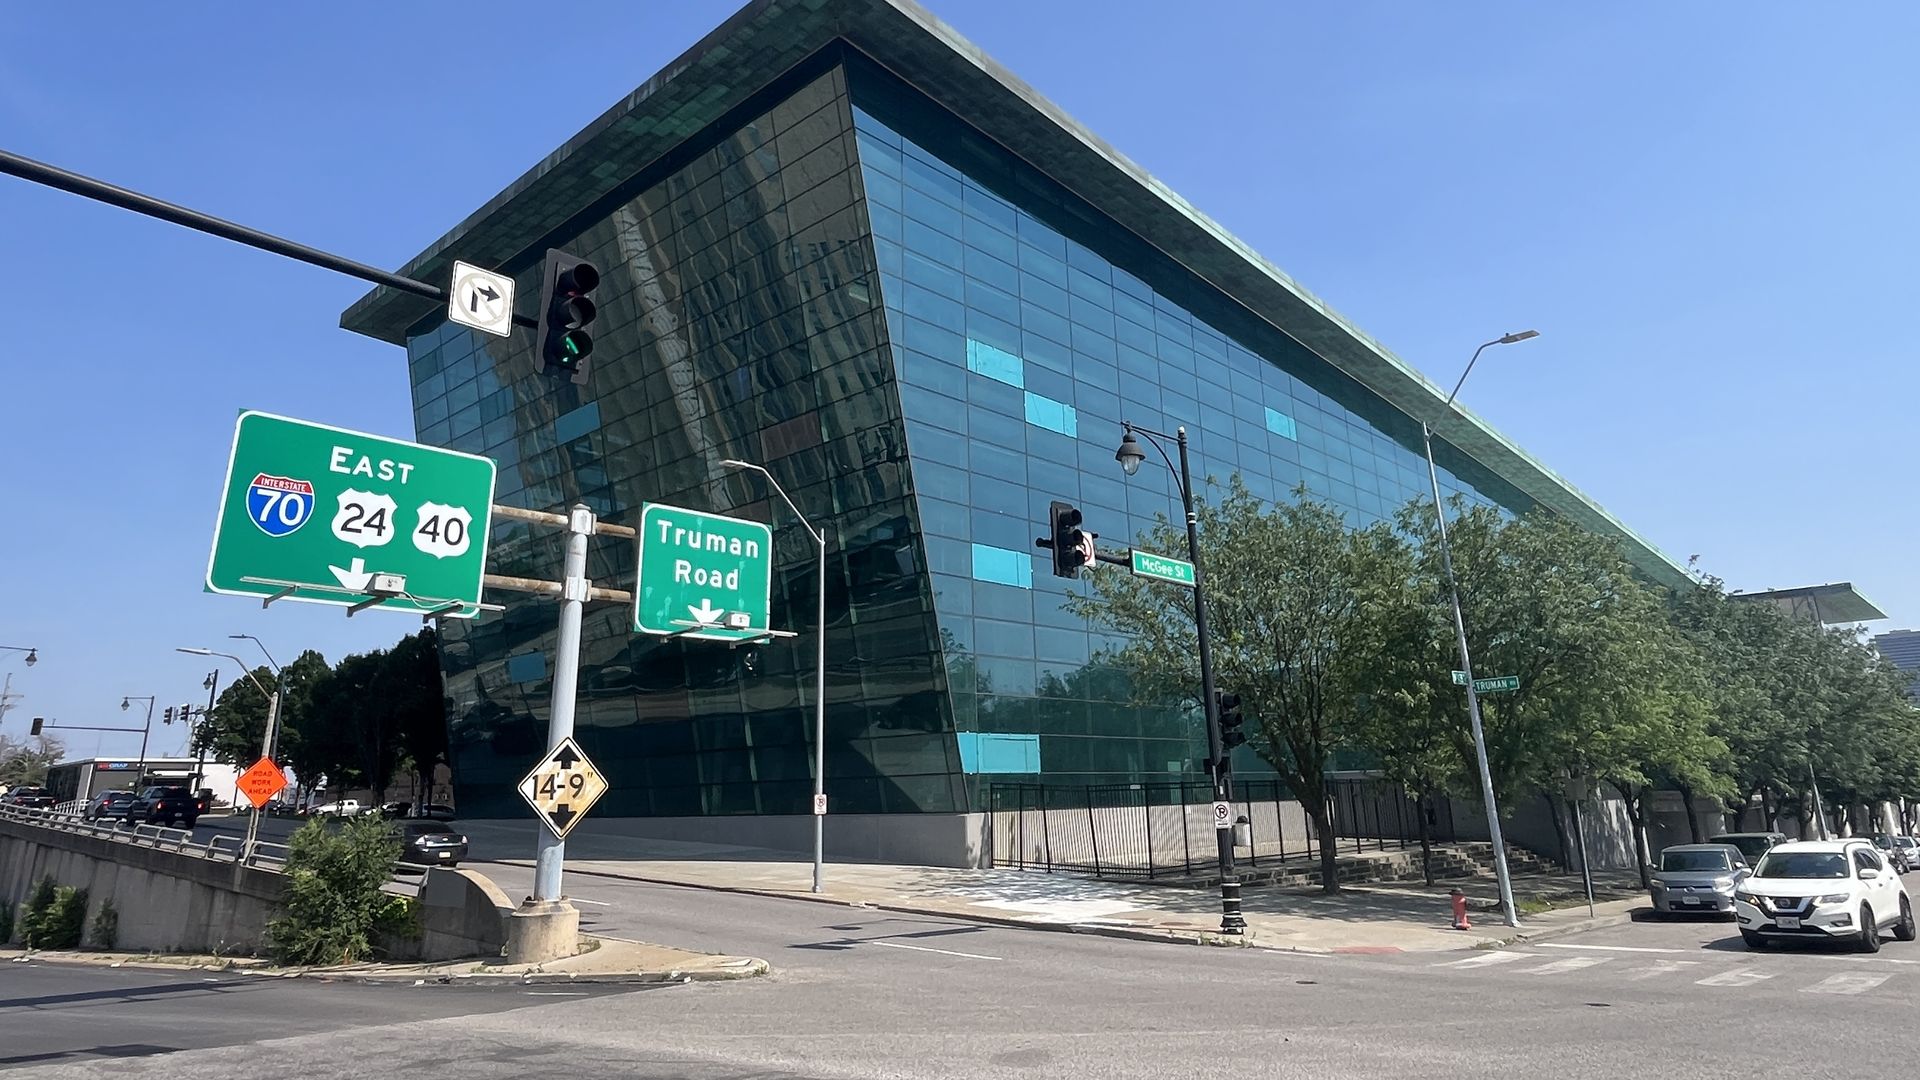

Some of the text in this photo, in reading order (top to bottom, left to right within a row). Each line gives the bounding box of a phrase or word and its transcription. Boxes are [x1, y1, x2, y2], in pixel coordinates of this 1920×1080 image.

[329, 445, 415, 485] EAST
[260, 476, 306, 492] INTERSTATE
[255, 488, 305, 527] 70
[340, 502, 387, 537] 24
[418, 514, 464, 546] 40
[656, 519, 759, 559] Truman
[674, 559, 739, 592] Road
[1141, 558, 1174, 576] McGee
[1475, 680, 1508, 690] TRUMAN
